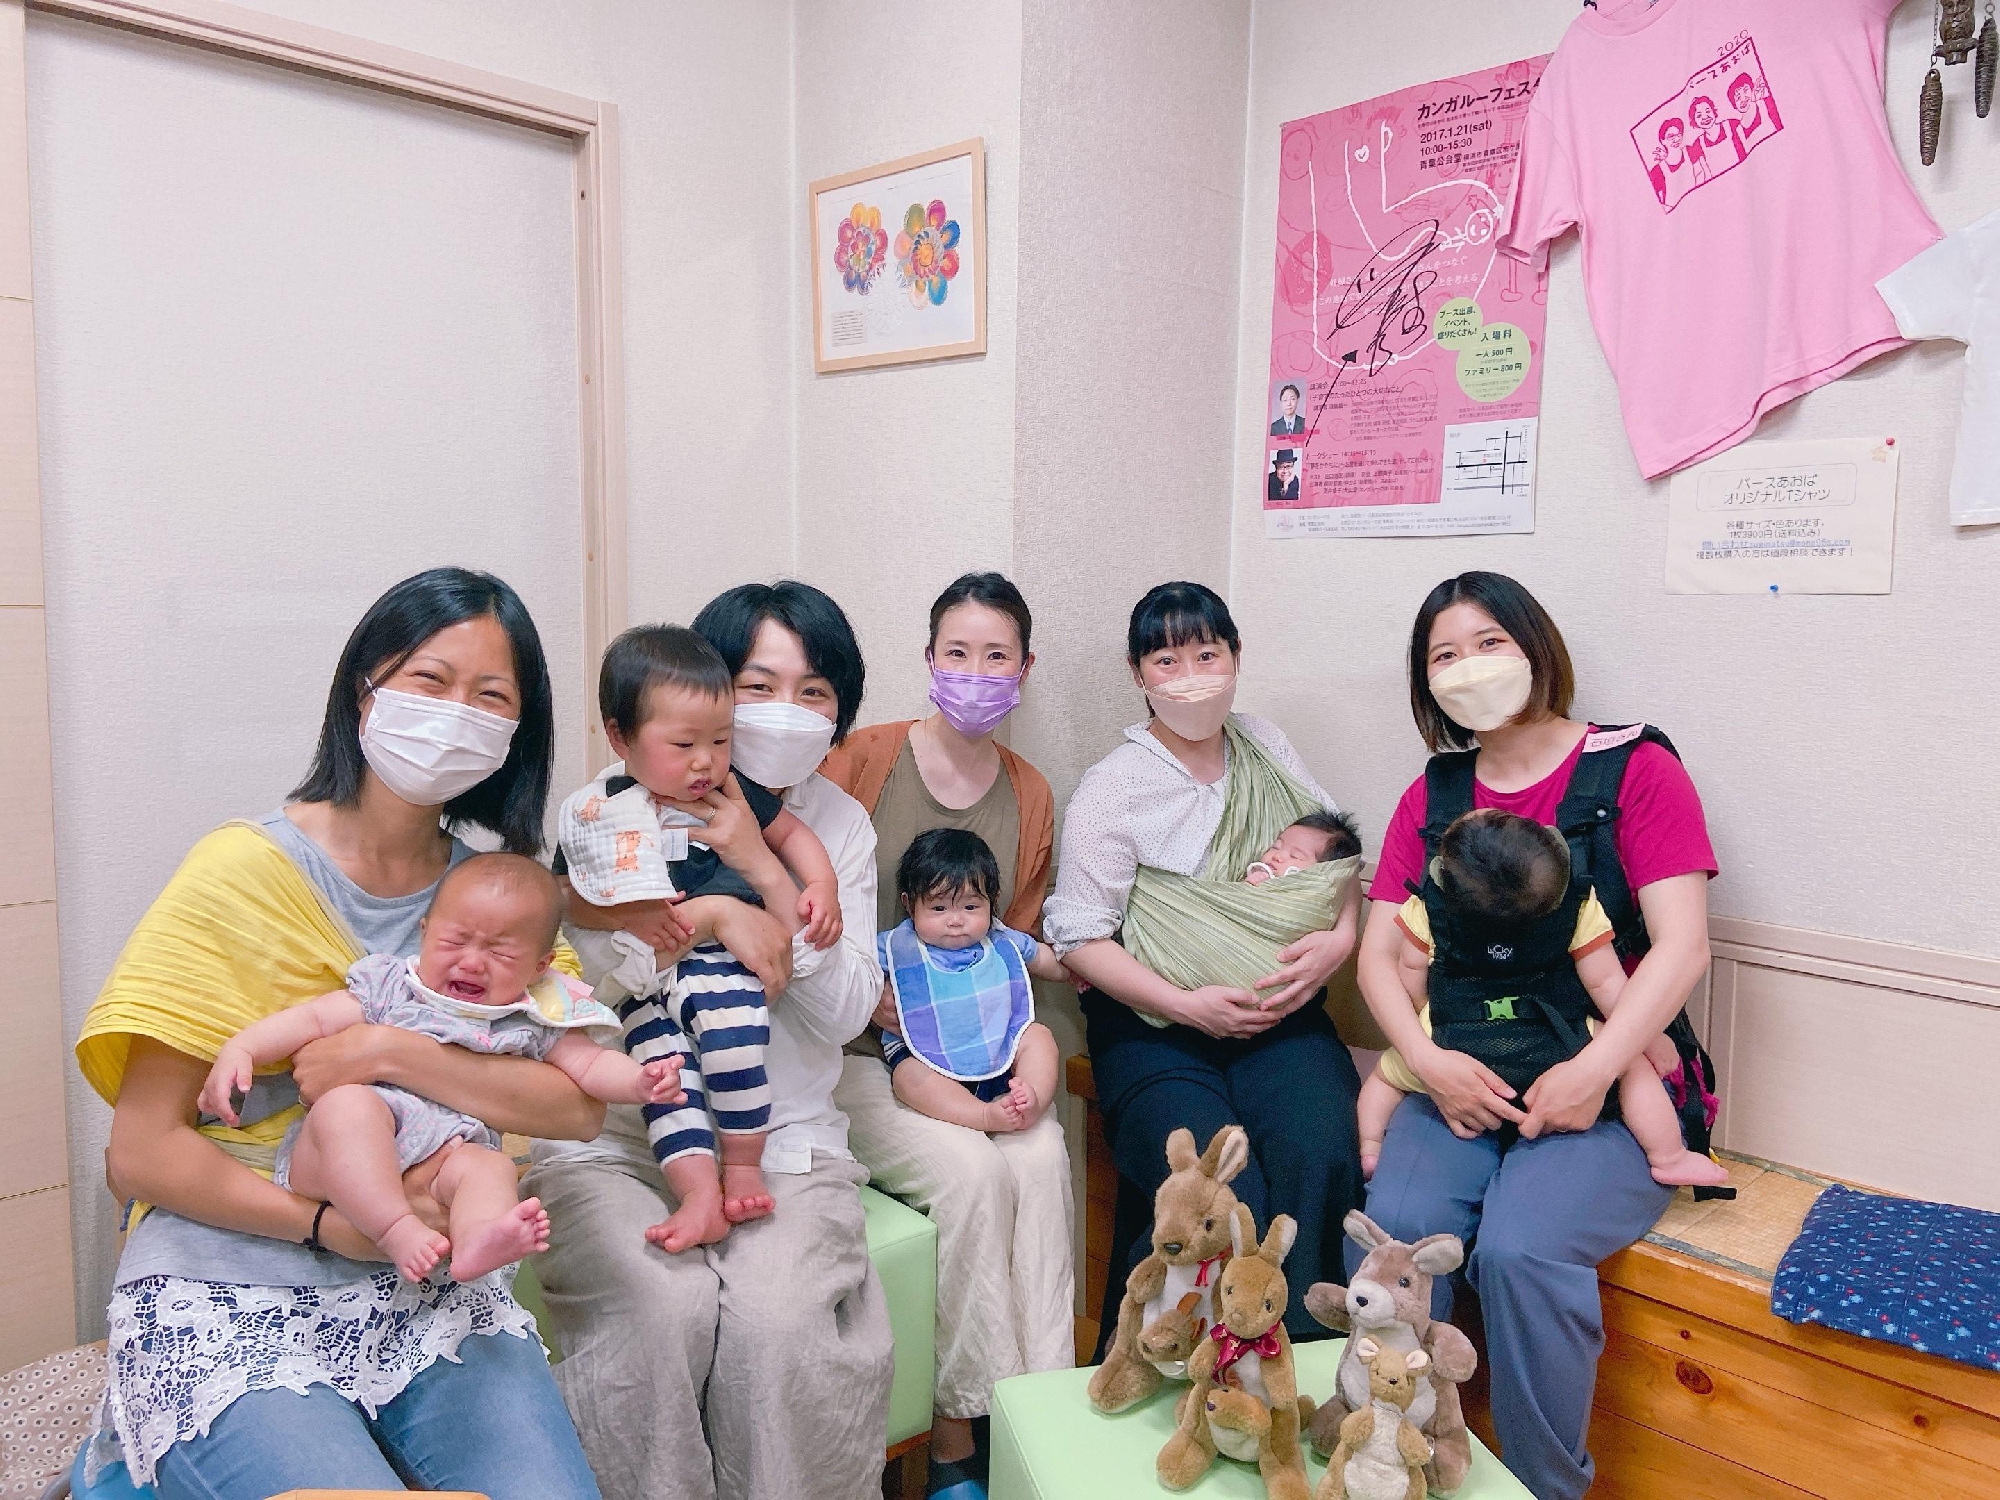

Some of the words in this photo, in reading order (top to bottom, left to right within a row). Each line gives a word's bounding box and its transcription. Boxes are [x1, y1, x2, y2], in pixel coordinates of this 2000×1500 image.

[1716, 29, 1749, 57] 2020
[1420, 119, 1493, 144] 2017.1.21(sat)
[1737, 474, 1818, 489] バースあおば
[1724, 489, 1831, 505] オリジナルTシャツ
